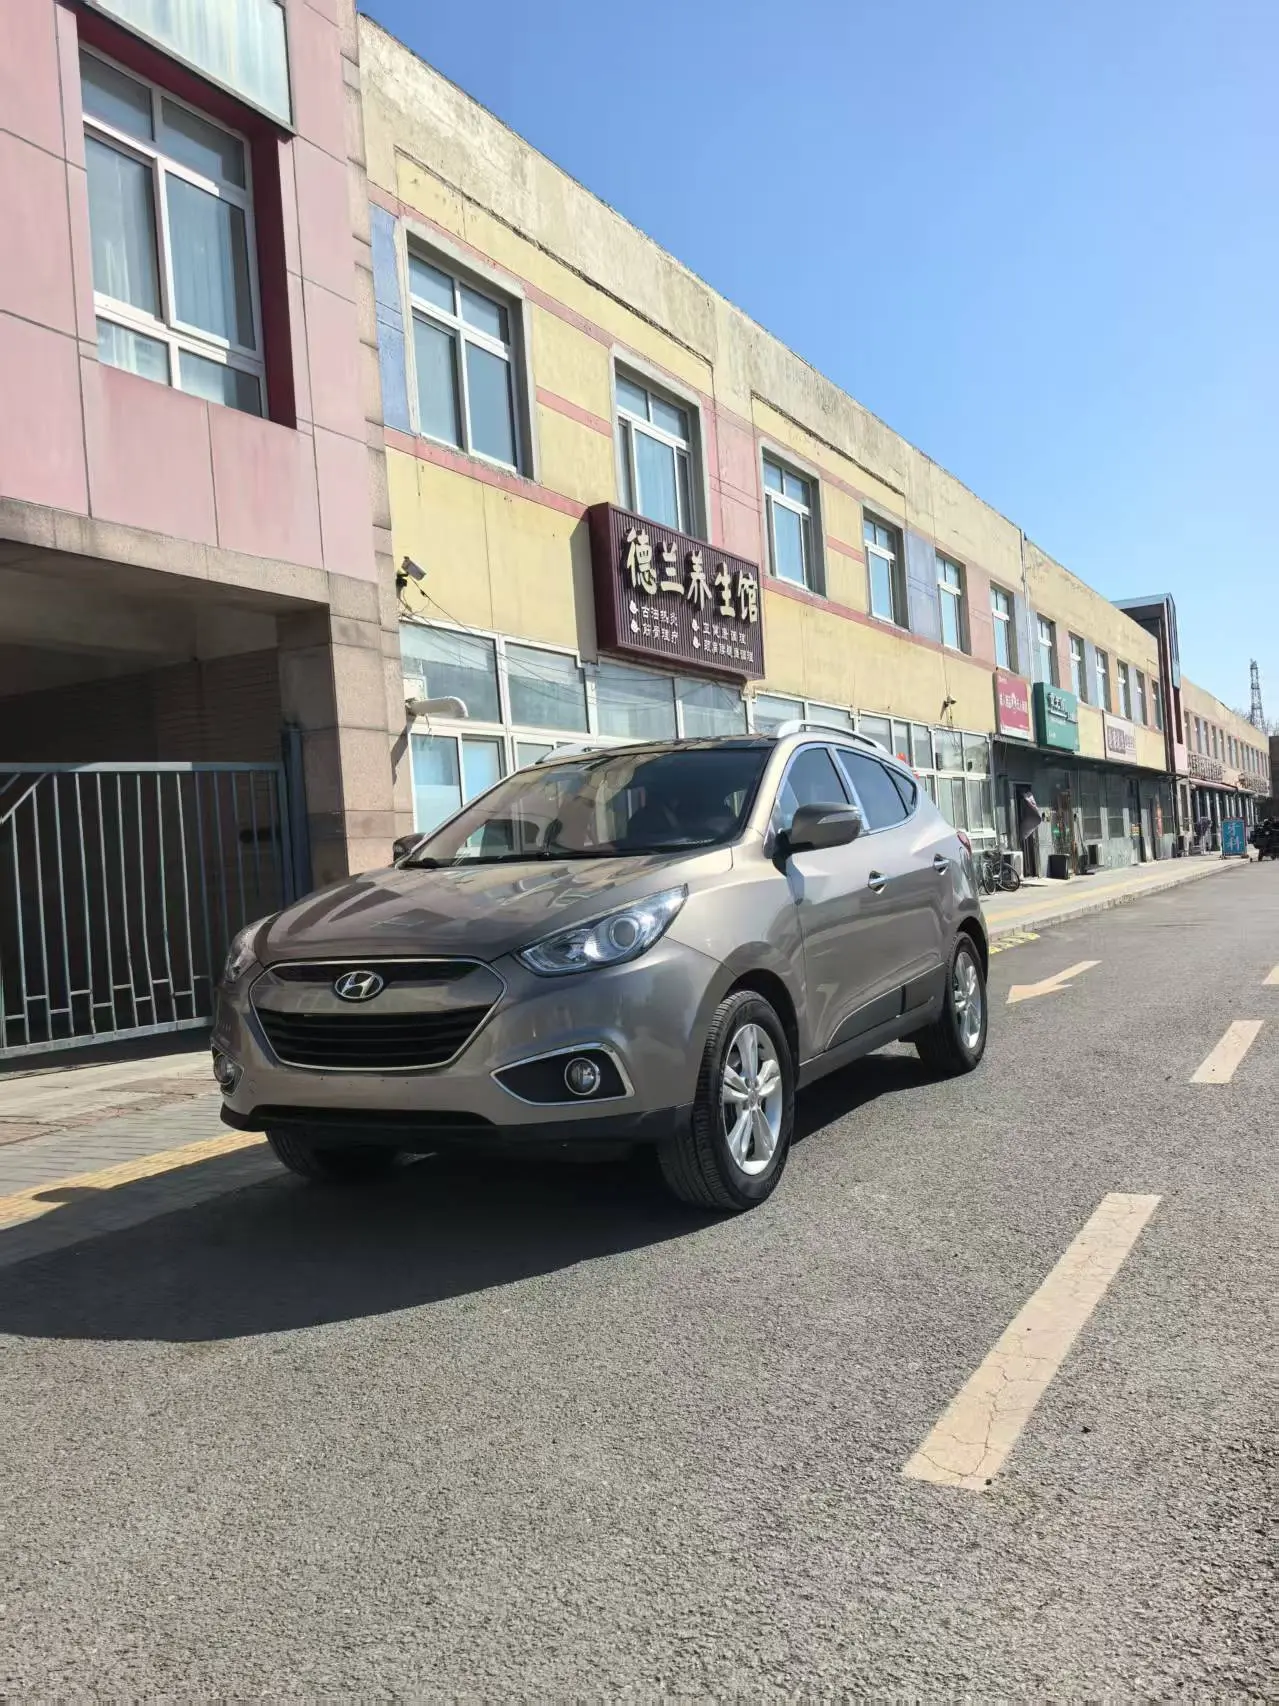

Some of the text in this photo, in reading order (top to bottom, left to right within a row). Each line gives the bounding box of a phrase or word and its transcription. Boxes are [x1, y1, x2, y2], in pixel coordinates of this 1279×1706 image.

[626, 526, 758, 623] 德兰养生馆
